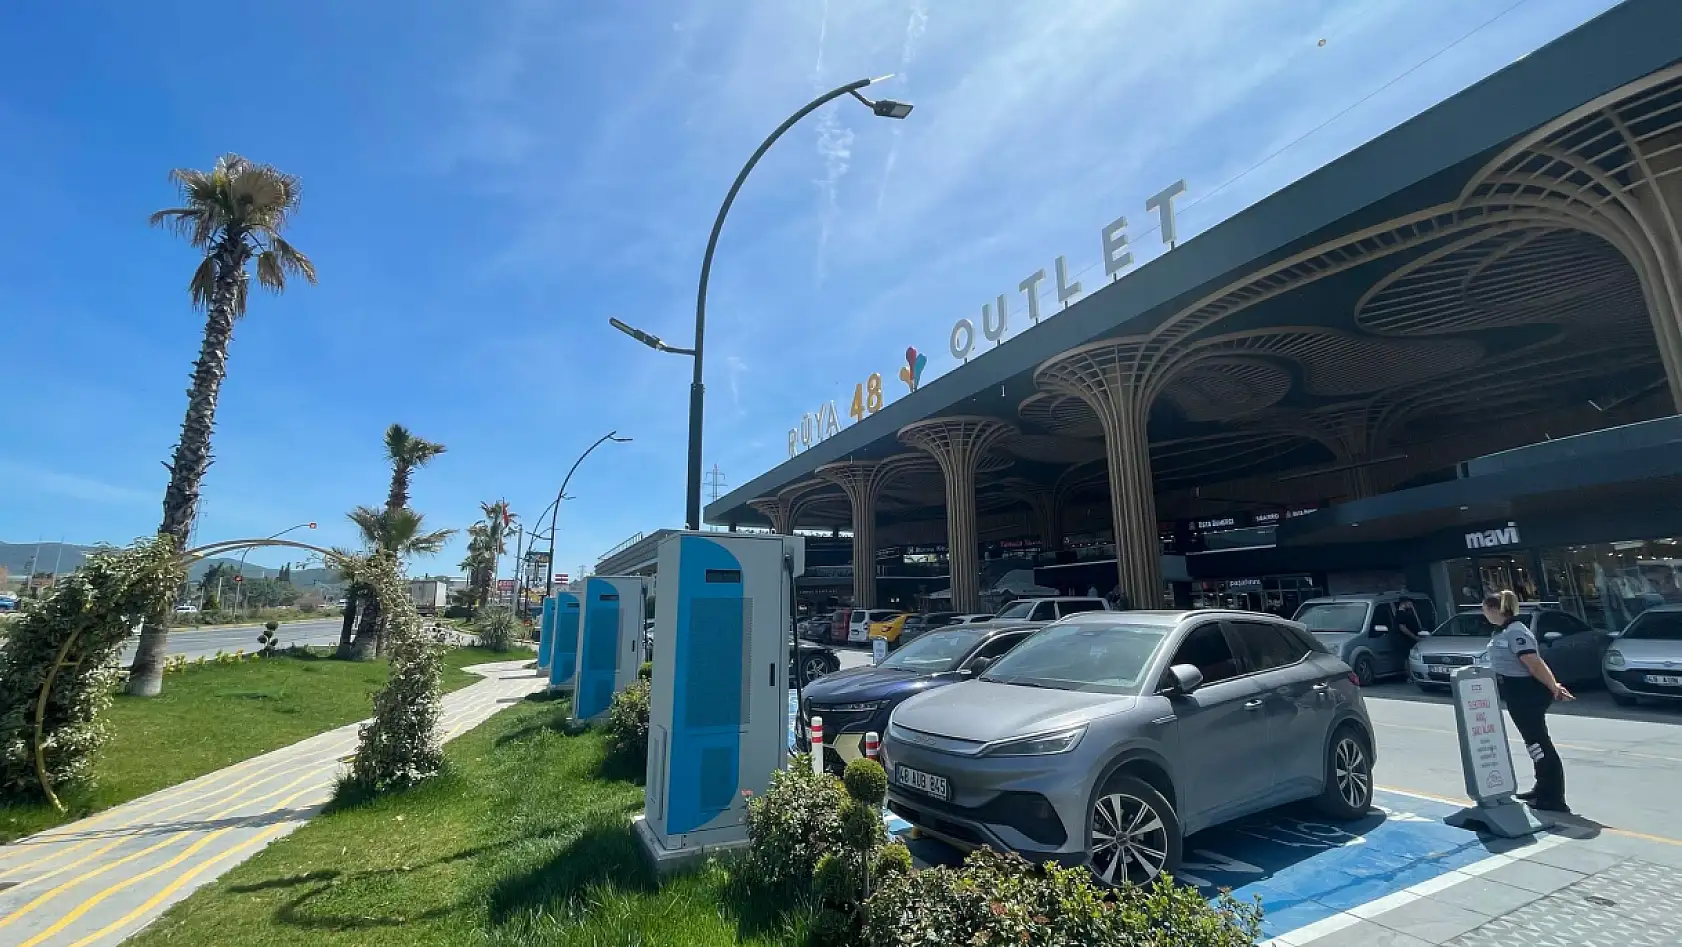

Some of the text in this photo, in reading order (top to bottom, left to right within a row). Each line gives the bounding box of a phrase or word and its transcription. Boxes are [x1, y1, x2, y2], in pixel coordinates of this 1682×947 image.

[788, 177, 1187, 458] RÜYA 48 OUTLET
[1464, 521, 1519, 549] mavi
